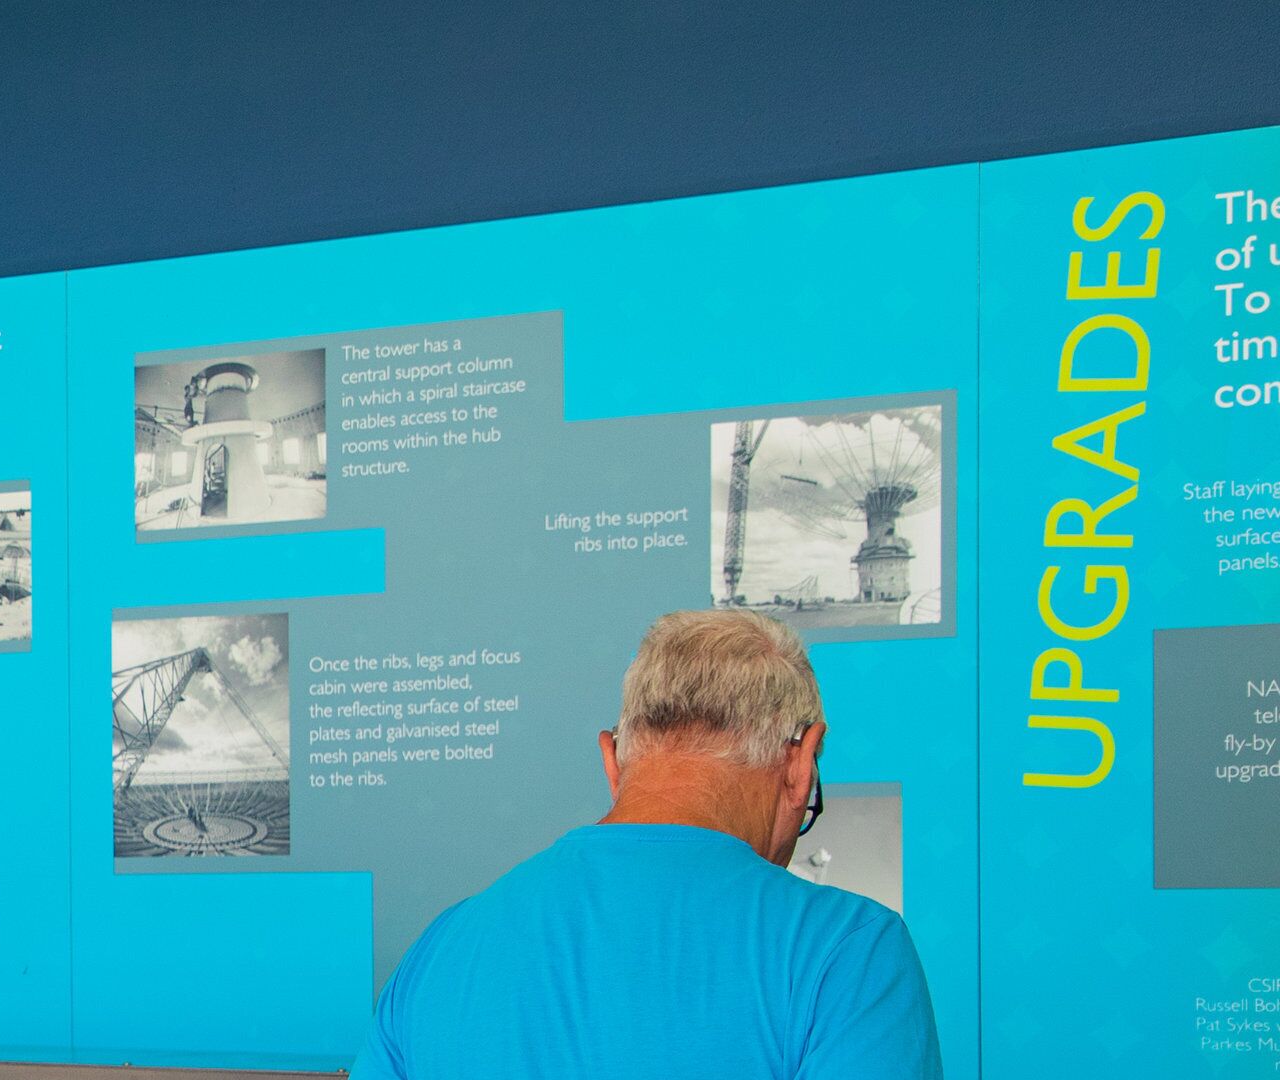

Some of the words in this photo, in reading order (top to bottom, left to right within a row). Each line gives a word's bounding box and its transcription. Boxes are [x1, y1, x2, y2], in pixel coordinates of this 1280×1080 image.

[1215, 235, 1258, 271] of
[1214, 282, 1271, 316] To
[342, 344, 370, 361] The
[374, 343, 420, 359] tower
[424, 338, 448, 353] has
[453, 339, 461, 351] a
[342, 365, 390, 385] central
[395, 360, 453, 382] support
[457, 356, 513, 374] column
[342, 393, 354, 408] in
[359, 388, 401, 407] which
[407, 390, 415, 402] a
[420, 382, 458, 404] spiral
[463, 380, 526, 397] staircase
[342, 413, 396, 431] enables
[401, 411, 447, 426] access
[451, 407, 468, 422] to
[473, 403, 497, 420] the
[342, 439, 389, 454] rooms
[393, 432, 438, 450] within
[443, 430, 467, 446] the
[472, 427, 501, 443] hub
[342, 460, 409, 477] structure.
[1022, 191, 1165, 789] UPGRADES
[1183, 480, 1225, 501] Staff
[545, 512, 591, 533] Lifting
[595, 511, 621, 527] the
[627, 507, 688, 528] support
[1203, 507, 1235, 524] the
[575, 536, 602, 553] ribs
[608, 535, 638, 551] into
[644, 532, 688, 553] place.
[309, 655, 350, 673] Once
[354, 655, 378, 672] the
[383, 653, 411, 670] ribs,
[417, 653, 444, 672] legs
[449, 649, 476, 667] and
[481, 648, 521, 665] focus
[309, 679, 346, 696] cabin
[351, 681, 388, 694] were
[393, 674, 472, 692] assembled,
[309, 703, 332, 719] the
[338, 700, 403, 721] reflecting
[407, 697, 459, 715] surface
[464, 696, 481, 713] of
[484, 695, 518, 712] steel
[310, 726, 351, 745] plates
[355, 724, 382, 740] and
[386, 721, 460, 743] galvanised
[465, 719, 499, 736] steel
[1224, 734, 1276, 756] fly-by
[1195, 997, 1248, 1012] Russell
[1196, 1017, 1220, 1031] Pat
[1227, 1017, 1271, 1034] Sykes
[1201, 1036, 1252, 1051] Parkes
